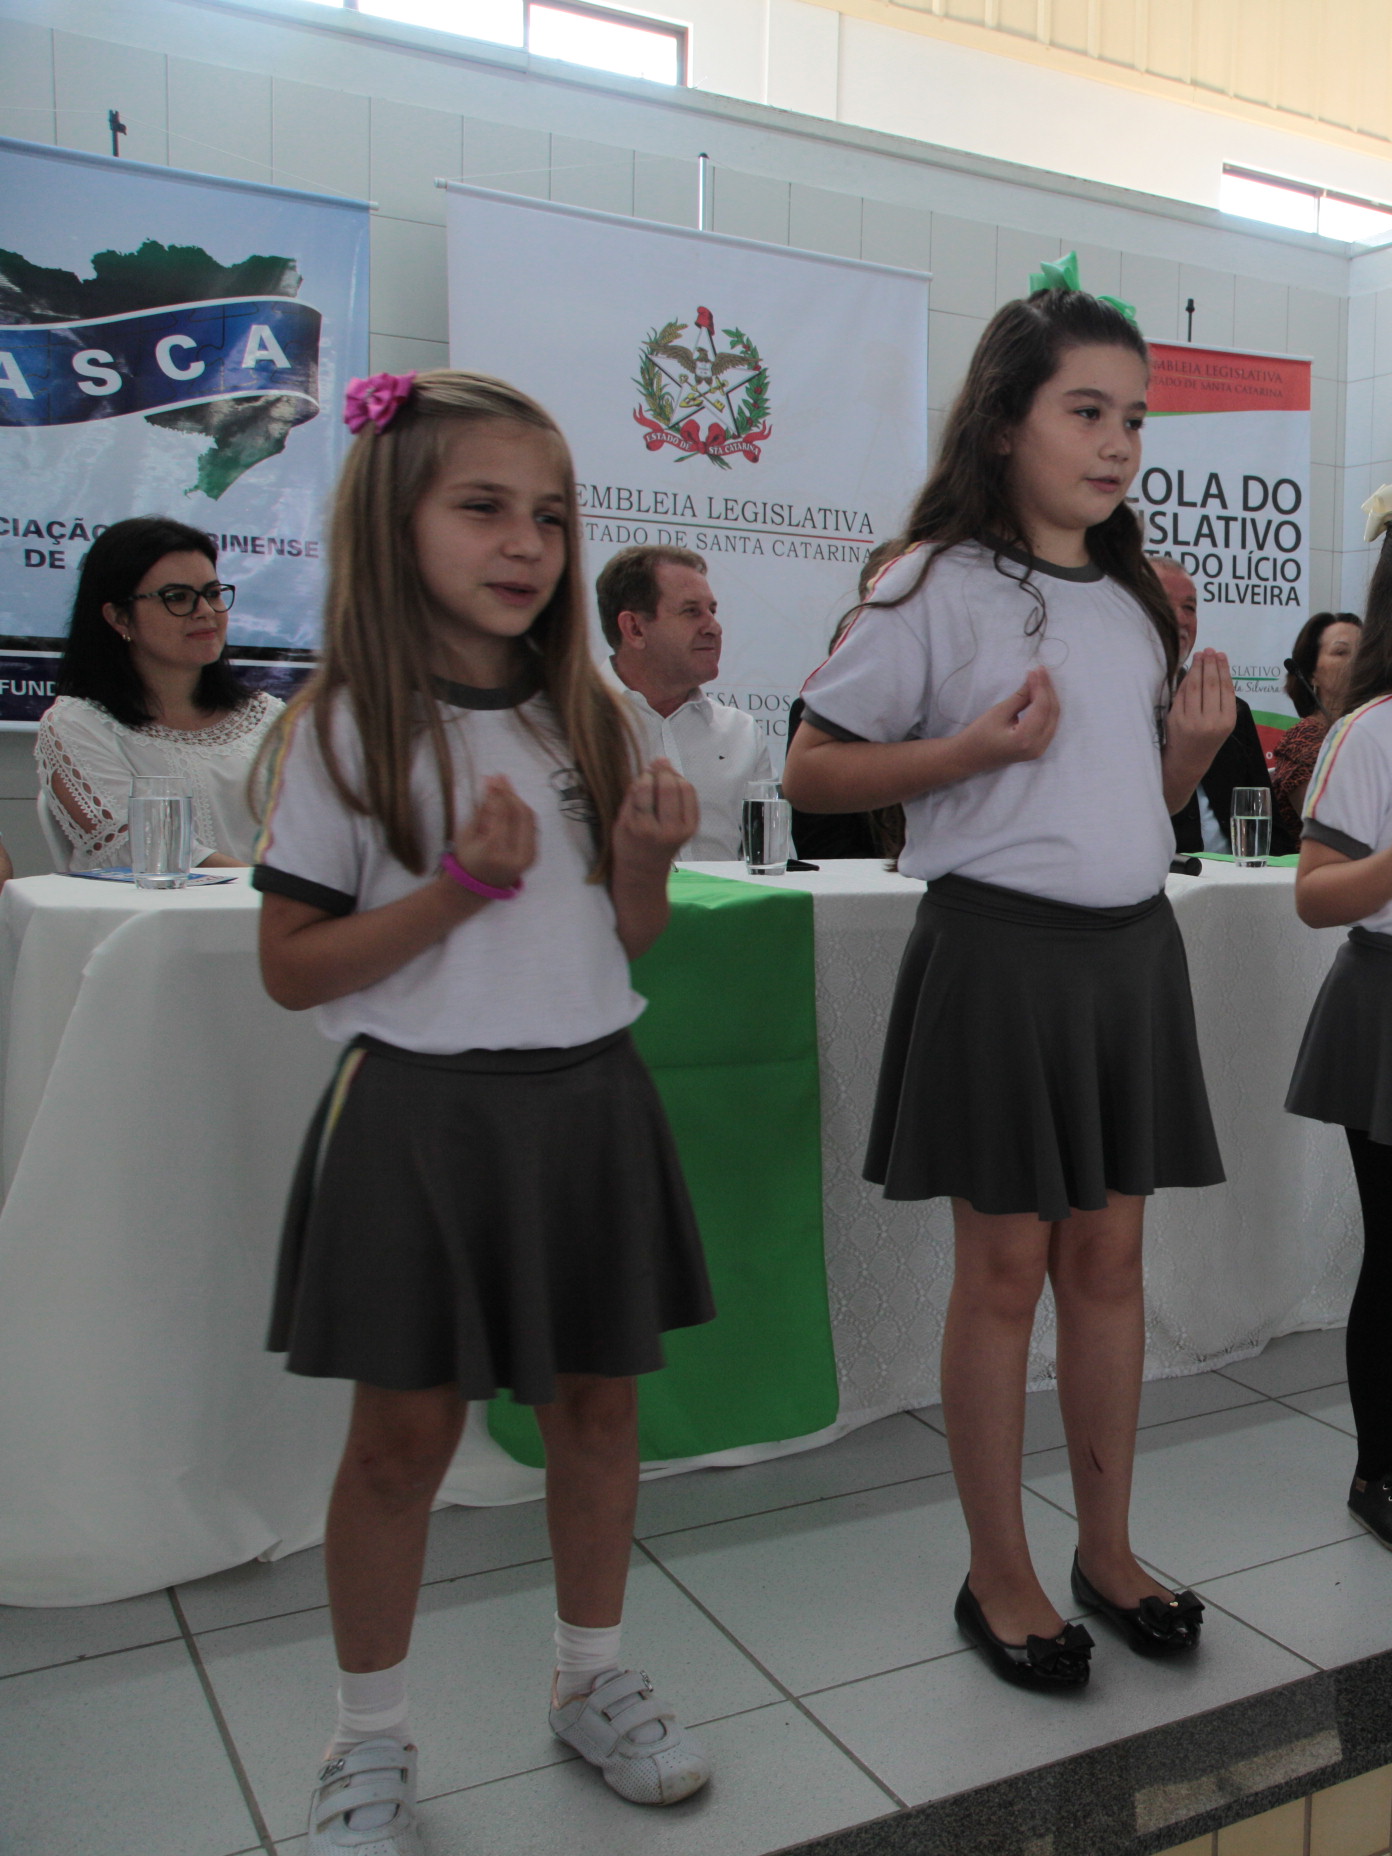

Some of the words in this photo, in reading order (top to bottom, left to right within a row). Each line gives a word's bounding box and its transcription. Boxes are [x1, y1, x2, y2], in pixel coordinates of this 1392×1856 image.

[1205, 364, 1283, 383] LEGISLATIVA
[1184, 379, 1197, 389] DE
[1200, 382, 1232, 393] SANTA
[1234, 384, 1283, 398] CATARINA
[646, 432, 679, 445] ESTADO
[680, 441, 691, 451] DE
[709, 446, 723, 454] STA
[1126, 467, 1229, 510] OLA
[1242, 475, 1302, 515] DO
[706, 496, 875, 535] LEGISLATIVA
[657, 528, 688, 549] DE
[696, 532, 765, 556] SANTA
[24, 548, 66, 570] DE
[1145, 549, 1223, 579] DO
[1232, 550, 1302, 583] LÍCIO
[1203, 582, 1301, 607] SILVEIRA
[1246, 681, 1280, 693] Silveira
